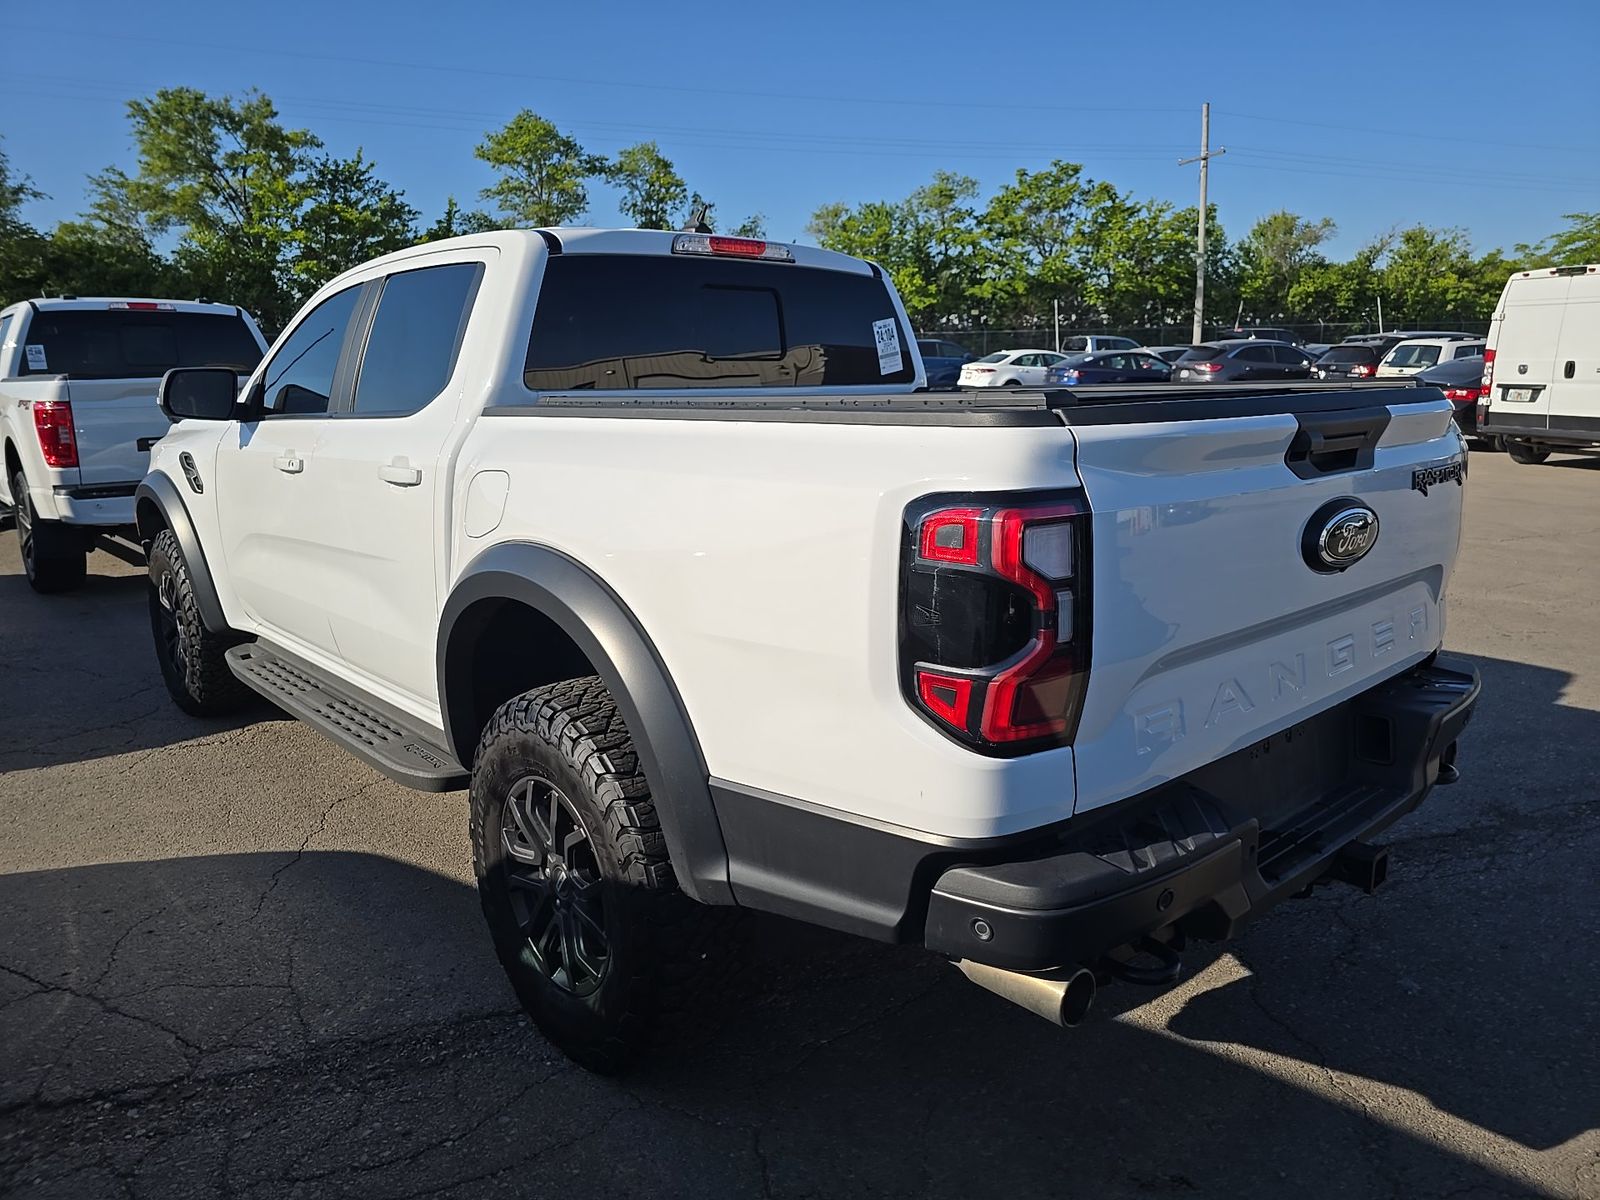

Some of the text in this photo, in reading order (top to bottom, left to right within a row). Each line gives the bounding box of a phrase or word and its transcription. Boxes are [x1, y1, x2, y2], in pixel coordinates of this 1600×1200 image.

[1412, 461, 1462, 497] RAPTOR
[1335, 522, 1370, 553] Ford
[1135, 602, 1429, 756] RANGER
